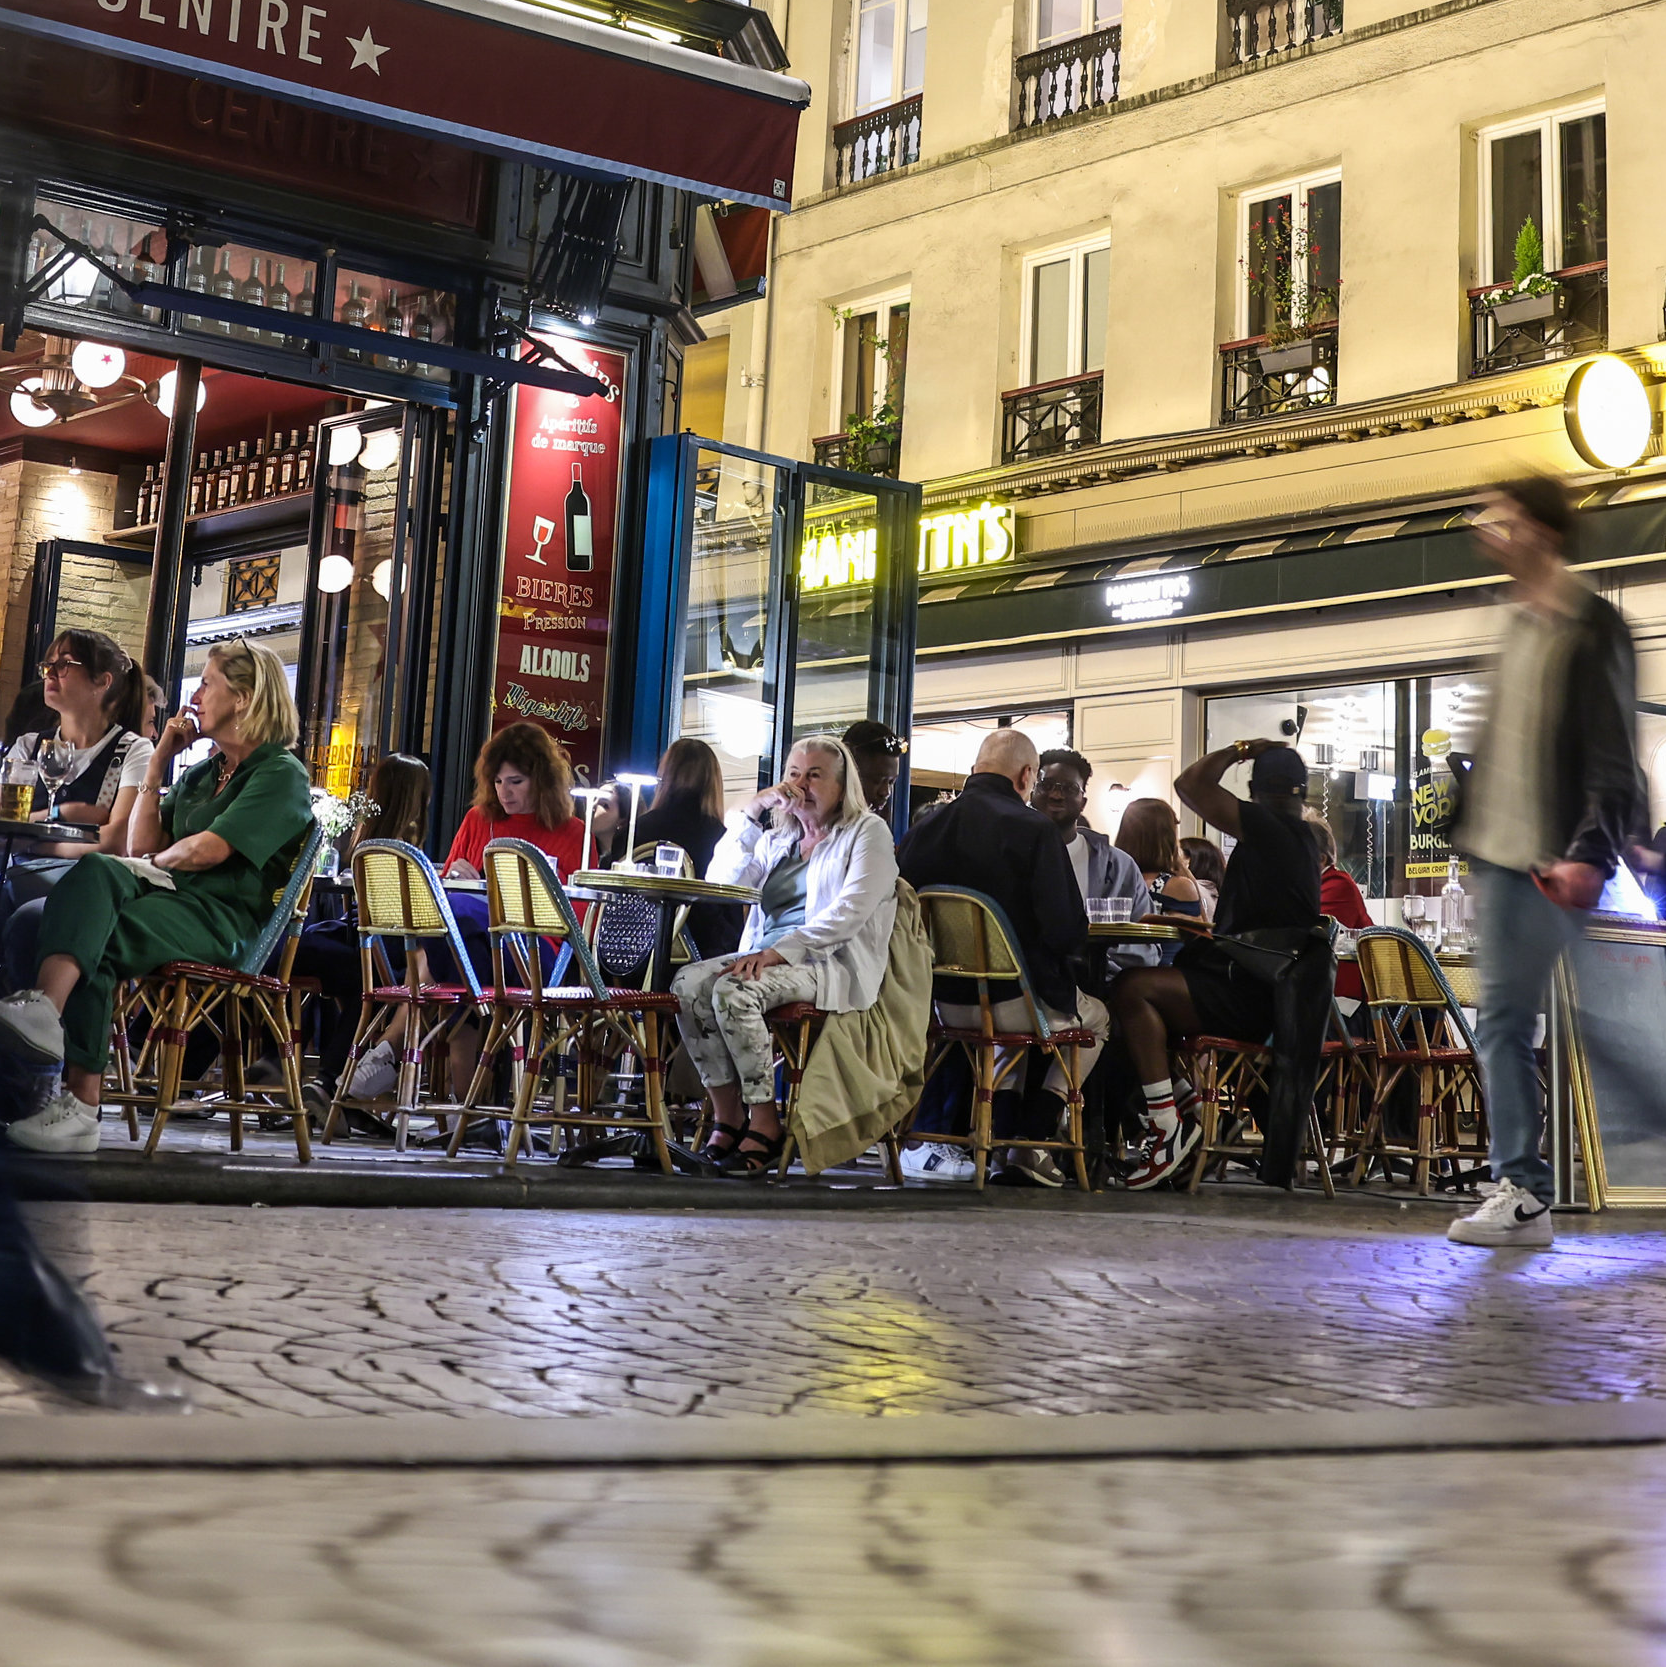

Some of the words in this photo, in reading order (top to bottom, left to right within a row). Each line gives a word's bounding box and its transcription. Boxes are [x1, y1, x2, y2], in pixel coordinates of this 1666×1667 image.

[531, 432, 549, 449] de
[552, 437, 606, 457] marque
[516, 575, 593, 608] BIERES
[519, 644, 591, 683] ALCOOLS
[502, 682, 589, 732] Digestifs
[1412, 778, 1451, 807] NEW
[1412, 795, 1455, 828] YOR
[1408, 865, 1431, 875] BELGIAN
[1431, 863, 1448, 874] CRAFT
